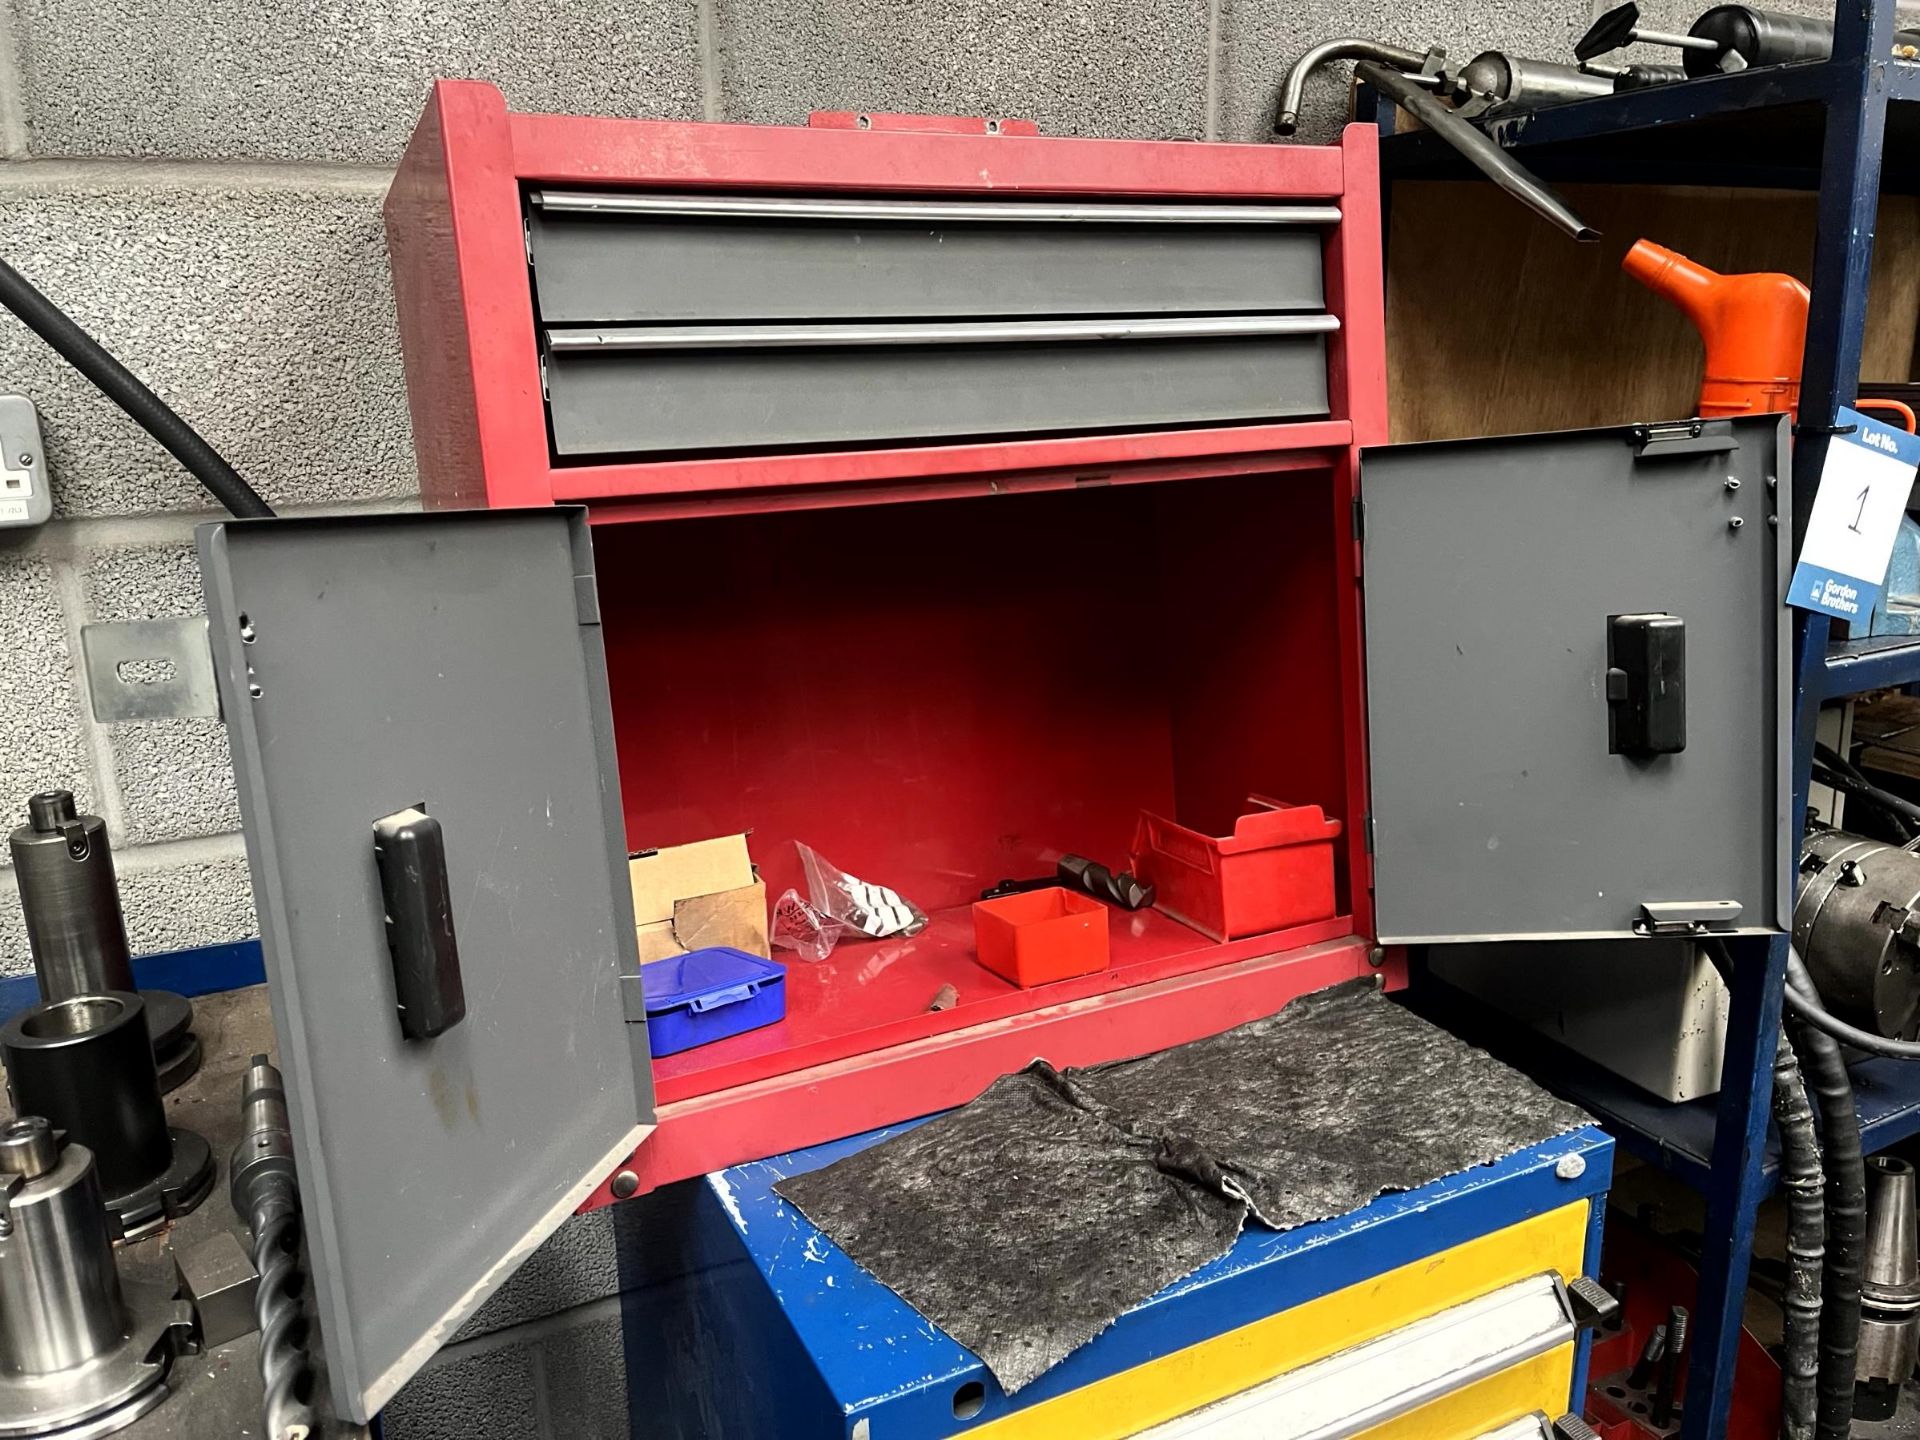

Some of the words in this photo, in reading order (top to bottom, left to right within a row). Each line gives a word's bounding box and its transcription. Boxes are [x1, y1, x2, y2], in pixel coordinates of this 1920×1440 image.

[1862, 427, 1880, 447] Lot
[1880, 433, 1898, 453] No.
[1848, 485, 1870, 535] 1
[1825, 578, 1857, 600] Gordon
[1821, 591, 1858, 614] Brothers
